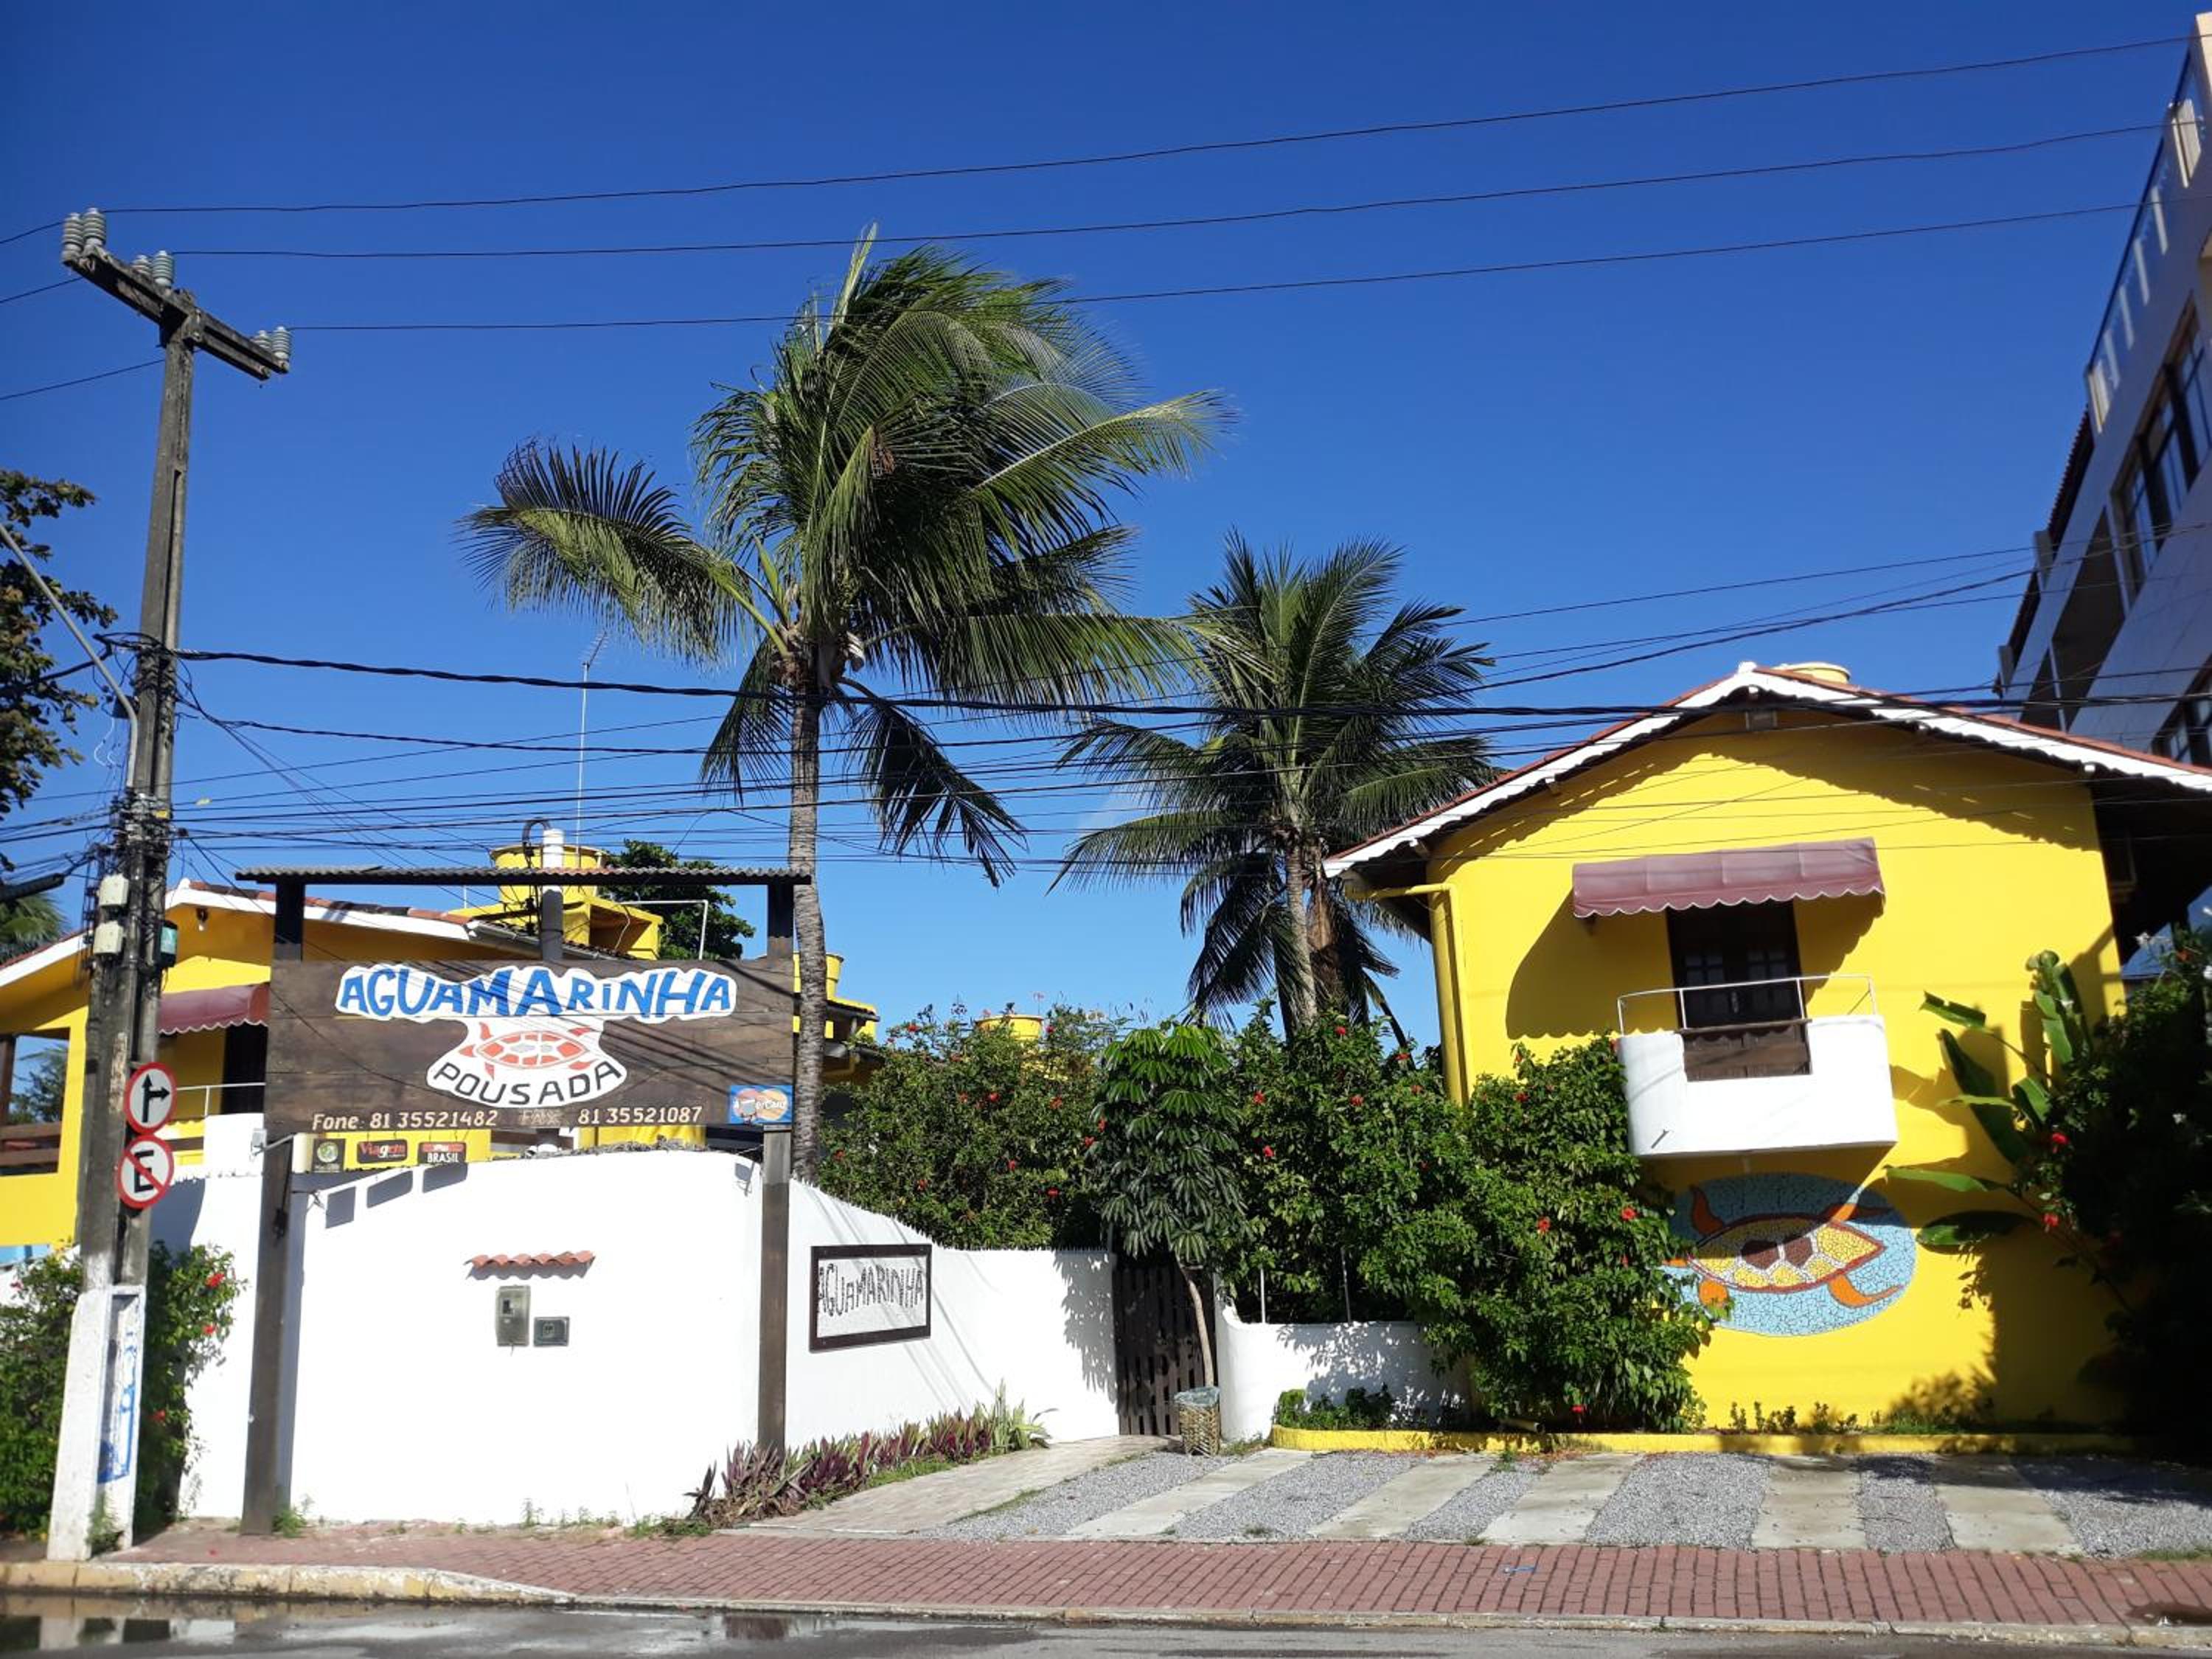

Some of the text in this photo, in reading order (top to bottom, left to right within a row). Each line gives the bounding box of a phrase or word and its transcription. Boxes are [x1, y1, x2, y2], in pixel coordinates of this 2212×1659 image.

[433, 1060, 623, 1105] POUSADA
[369, 1113, 390, 1130] 81
[397, 1110, 498, 1129] 35521482
[577, 1108, 599, 1125] 81
[605, 1107, 703, 1124] 35521087
[426, 1152, 459, 1163] BRASIL
